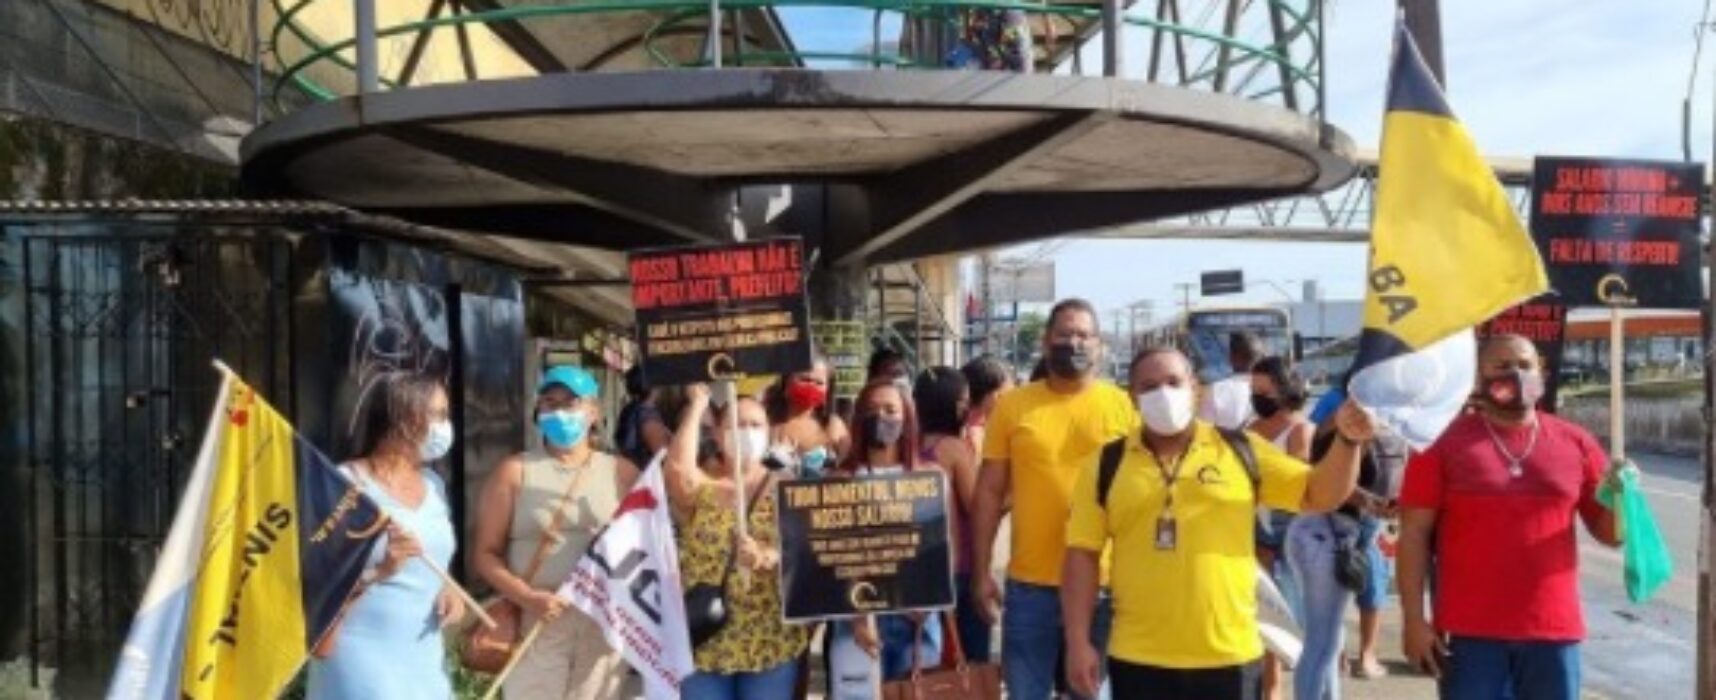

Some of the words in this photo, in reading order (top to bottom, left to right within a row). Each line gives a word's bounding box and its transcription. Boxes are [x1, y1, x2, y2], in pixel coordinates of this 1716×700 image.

[1550, 238, 1593, 263] FALTA
[1595, 239, 1612, 263] DE
[630, 256, 678, 282] NOSSO
[810, 506, 854, 530] NOSSO
